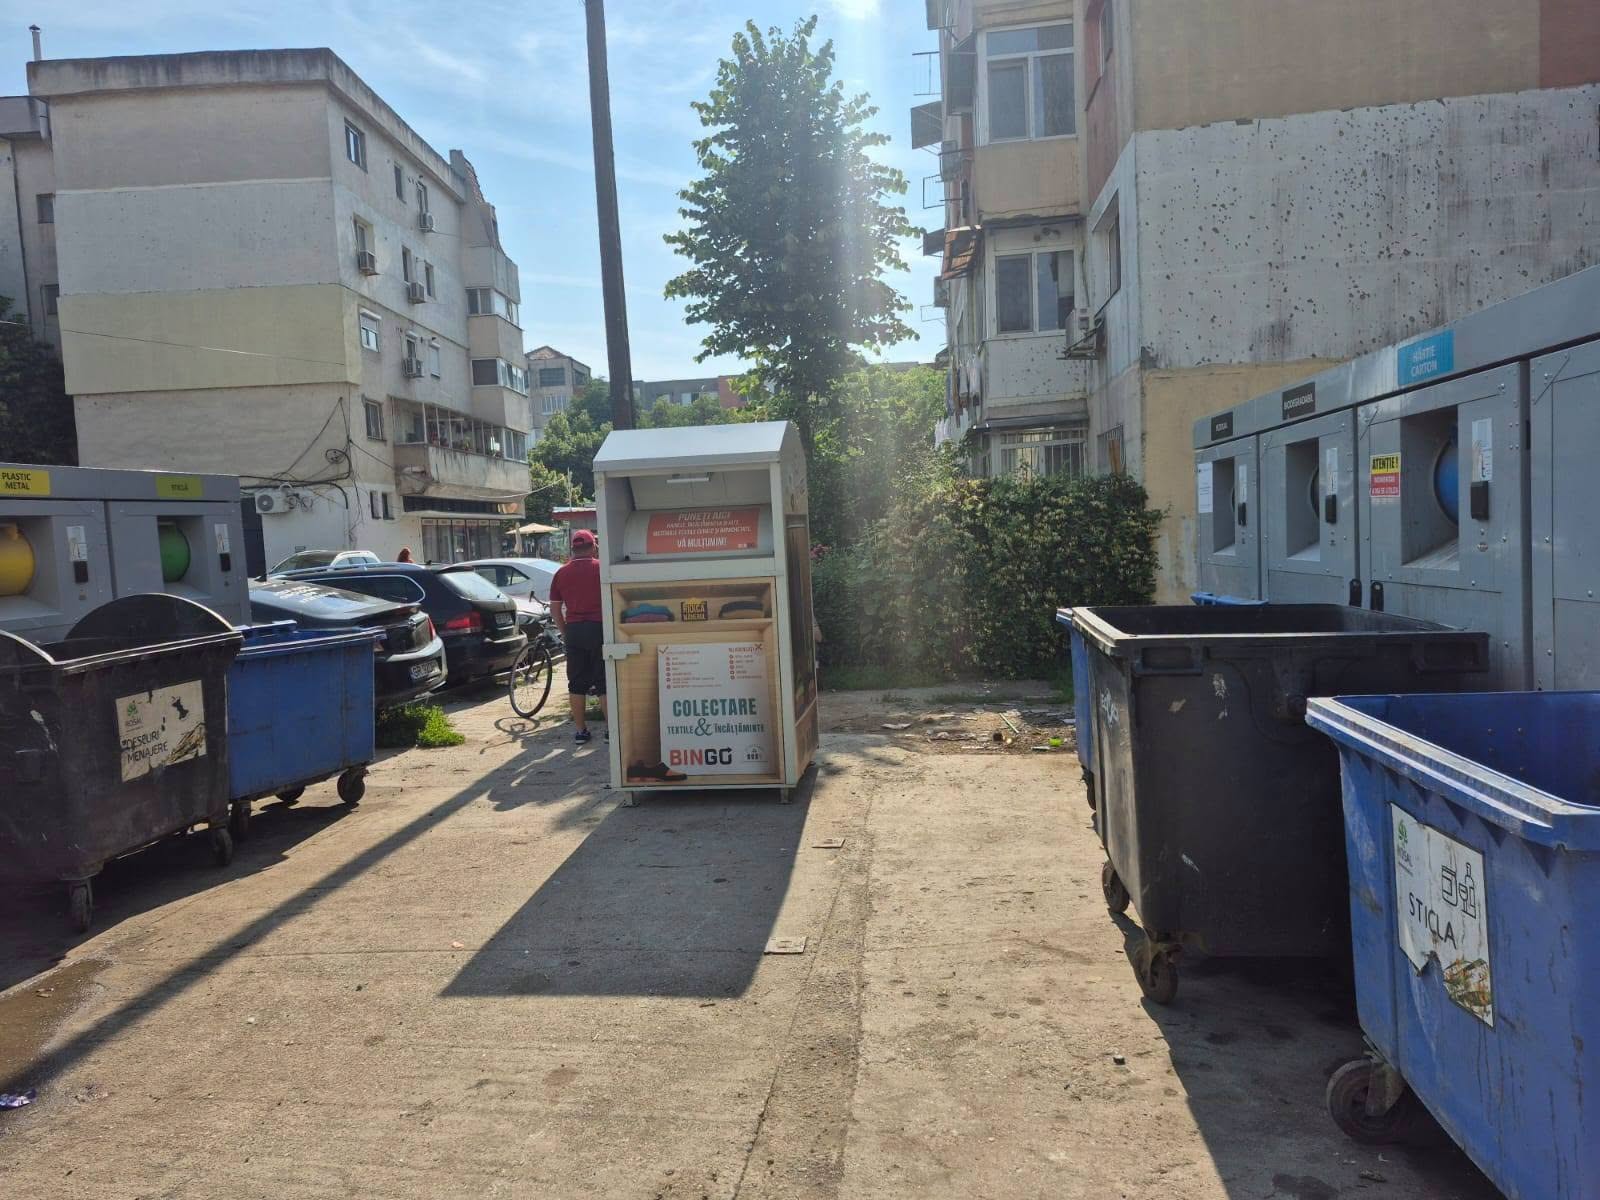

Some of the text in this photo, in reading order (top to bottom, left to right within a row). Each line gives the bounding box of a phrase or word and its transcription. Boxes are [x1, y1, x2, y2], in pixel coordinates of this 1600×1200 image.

[1410, 359, 1438, 377] CARTON
[1, 472, 32, 481] PLASTIC
[4, 481, 31, 490] METAL
[672, 698, 757, 717] COLECTARE
[667, 725, 694, 735] TEXTILE
[695, 717, 712, 736] &
[127, 741, 169, 764] MENAJERE
[669, 746, 732, 766] BINGO
[1408, 891, 1457, 950] STICLA
